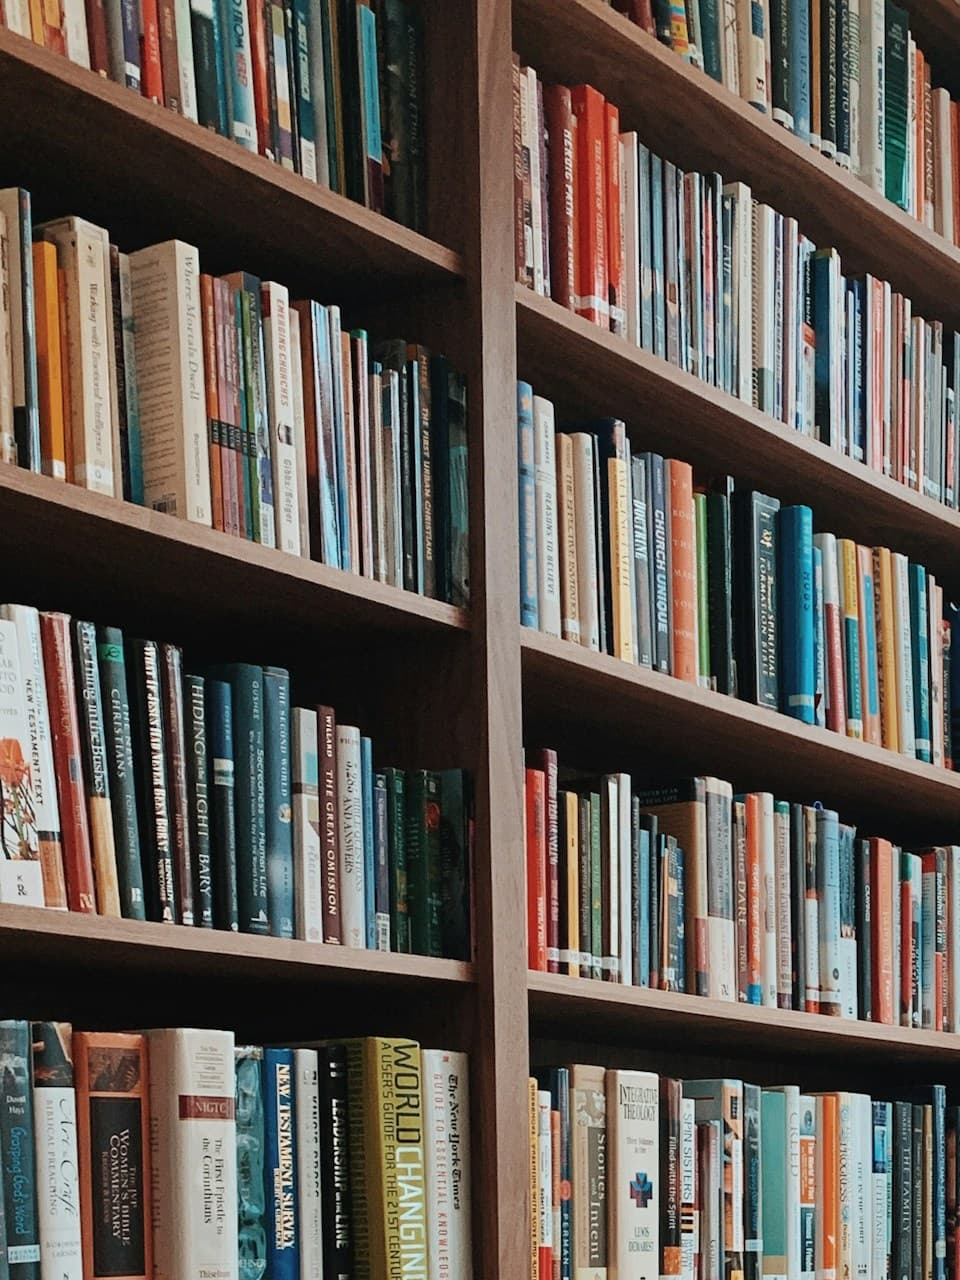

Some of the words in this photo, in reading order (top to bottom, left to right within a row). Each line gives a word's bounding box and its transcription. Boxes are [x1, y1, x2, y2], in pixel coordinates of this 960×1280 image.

[512, 92, 521, 134] FINGER
[924, 82, 932, 133] LIGHT
[514, 136, 521, 150] OF
[563, 129, 573, 180] HEROIC
[514, 154, 522, 181] GOD
[564, 184, 574, 217] PATH
[183, 256, 195, 301] Where
[186, 304, 198, 358] Mortals
[276, 299, 287, 350] EMERGING
[188, 360, 199, 400] Dwell
[279, 352, 289, 406] CHURCHES
[422, 408, 430, 426] THE
[422, 430, 430, 456] FIRST
[423, 461, 431, 497] URBAN
[424, 500, 433, 560] CHRISTIANS
[545, 492, 553, 536] REASONS
[633, 500, 647, 561] DOCTRINE
[546, 539, 554, 552] TO
[654, 510, 666, 571] CHURCH
[546, 555, 555, 595] BELIEVE
[657, 573, 668, 633] UNIQUE
[759, 557, 767, 635] FORMATION
[81, 626, 94, 654] The
[767, 615, 776, 677] SPIRITUAL
[25, 678, 35, 704] NEW
[83, 657, 98, 699] Thing
[278, 686, 288, 705] THE
[88, 703, 100, 718] in
[122, 703, 131, 732] THE
[147, 692, 159, 725] JESUS
[191, 685, 207, 754] HIDING
[27, 708, 41, 774] TESTAMENT
[89, 719, 101, 742] the
[111, 688, 127, 779] CHRISTIANS
[150, 728, 161, 750] HAD
[279, 710, 289, 754] SECOND
[92, 744, 105, 793] Bushes
[126, 736, 135, 767] NEW
[151, 753, 164, 786] NEVER
[34, 777, 43, 805] TEXT
[256, 749, 266, 814] Sacredness
[280, 758, 289, 797] WORLD
[325, 769, 334, 798] THE
[154, 788, 165, 816] BEEN
[195, 782, 209, 840] LIGHT
[343, 797, 352, 822] AND
[156, 818, 169, 851] BORN?
[326, 802, 336, 846] GREAT
[258, 831, 267, 871] Human
[344, 824, 354, 874] ANSWERS
[198, 854, 211, 898] BARY
[259, 876, 268, 897] Life
[326, 850, 337, 916] OMISSION
[738, 880, 747, 927] DARE
[381, 1042, 391, 1050] A
[278, 1065, 291, 1097] NEW
[382, 1054, 394, 1099] USER'S
[433, 1073, 444, 1111] GUIDE
[449, 1074, 459, 1099] The
[46, 1099, 57, 1147] BIBLICAL
[195, 1102, 228, 1114] NIGTC
[383, 1103, 394, 1140] GUIDE
[435, 1119, 445, 1132] TO
[449, 1102, 460, 1132] New
[623, 1104, 656, 1122] THEOLOGY
[201, 1138, 210, 1152] the
[215, 1138, 223, 1154] The
[279, 1103, 293, 1189] TESTAMENT
[332, 1099, 347, 1194] LEADERSHIP
[682, 1113, 692, 1143] SPIN
[10, 1126, 26, 1173] Grasping
[120, 1129, 130, 1200] WOMEN'S
[385, 1145, 396, 1170] FOR
[449, 1133, 461, 1167] York
[597, 1133, 607, 1200] Stories
[668, 1136, 677, 1161] Filled
[12, 1175, 29, 1203] God's
[48, 1150, 58, 1216] PREACHING
[110, 1135, 121, 1239] COMMENTARY
[202, 1155, 214, 1224] Corinthians
[215, 1158, 224, 1183] First
[386, 1175, 397, 1198] THE
[436, 1140, 446, 1205] ESSENTIAL
[452, 1169, 462, 1210] Times
[669, 1163, 677, 1182] with
[683, 1146, 693, 1200] SISTERS
[839, 1143, 848, 1202] PROGRESS
[858, 1184, 864, 1193] IN
[215, 1186, 225, 1222] Epistle
[668, 1187, 677, 1202] the
[903, 1181, 911, 1233] FAMILY
[15, 1206, 30, 1235] Word
[121, 1205, 131, 1246] BIBLE
[216, 1226, 224, 1235] to
[282, 1193, 295, 1249] SURVEY
[335, 1215, 347, 1249] LINE
[387, 1201, 399, 1233] 21ST
[590, 1201, 601, 1261] Intent
[668, 1205, 677, 1229] Spirit
[562, 1213, 570, 1265] PERMAN
